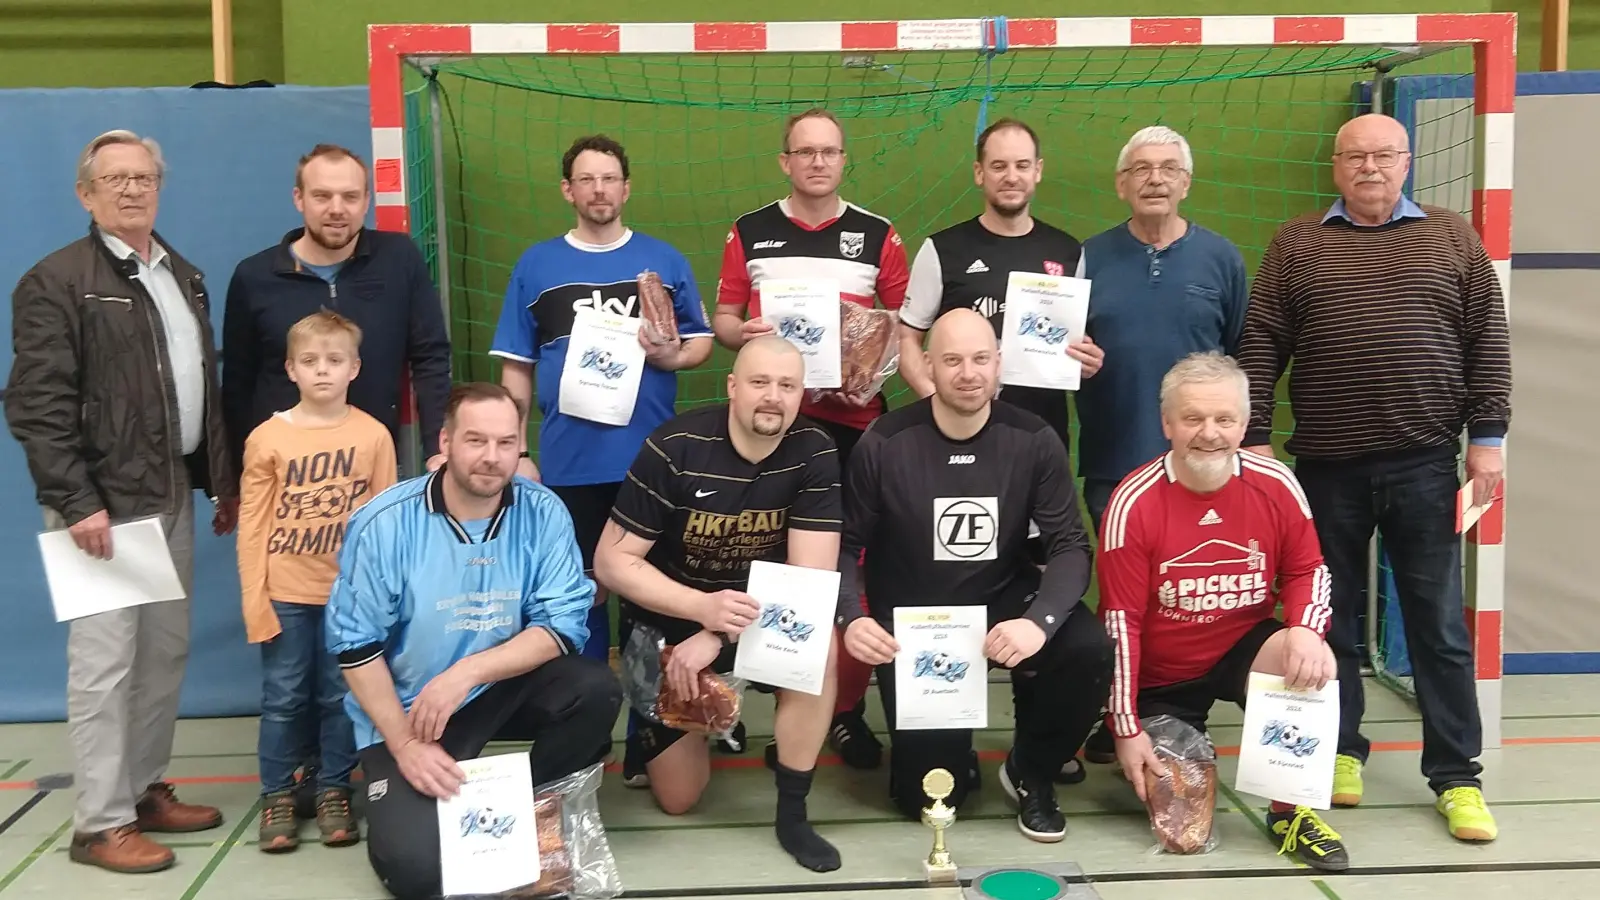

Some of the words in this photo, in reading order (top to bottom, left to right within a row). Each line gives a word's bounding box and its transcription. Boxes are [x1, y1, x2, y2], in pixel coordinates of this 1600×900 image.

[285, 446, 356, 488] NON
[948, 454, 976, 464] JAKO
[268, 521, 345, 555] GAMIN
[940, 513, 992, 546] ZF
[1178, 572, 1267, 597] PICKEL
[1178, 589, 1267, 612] BIOGAS
